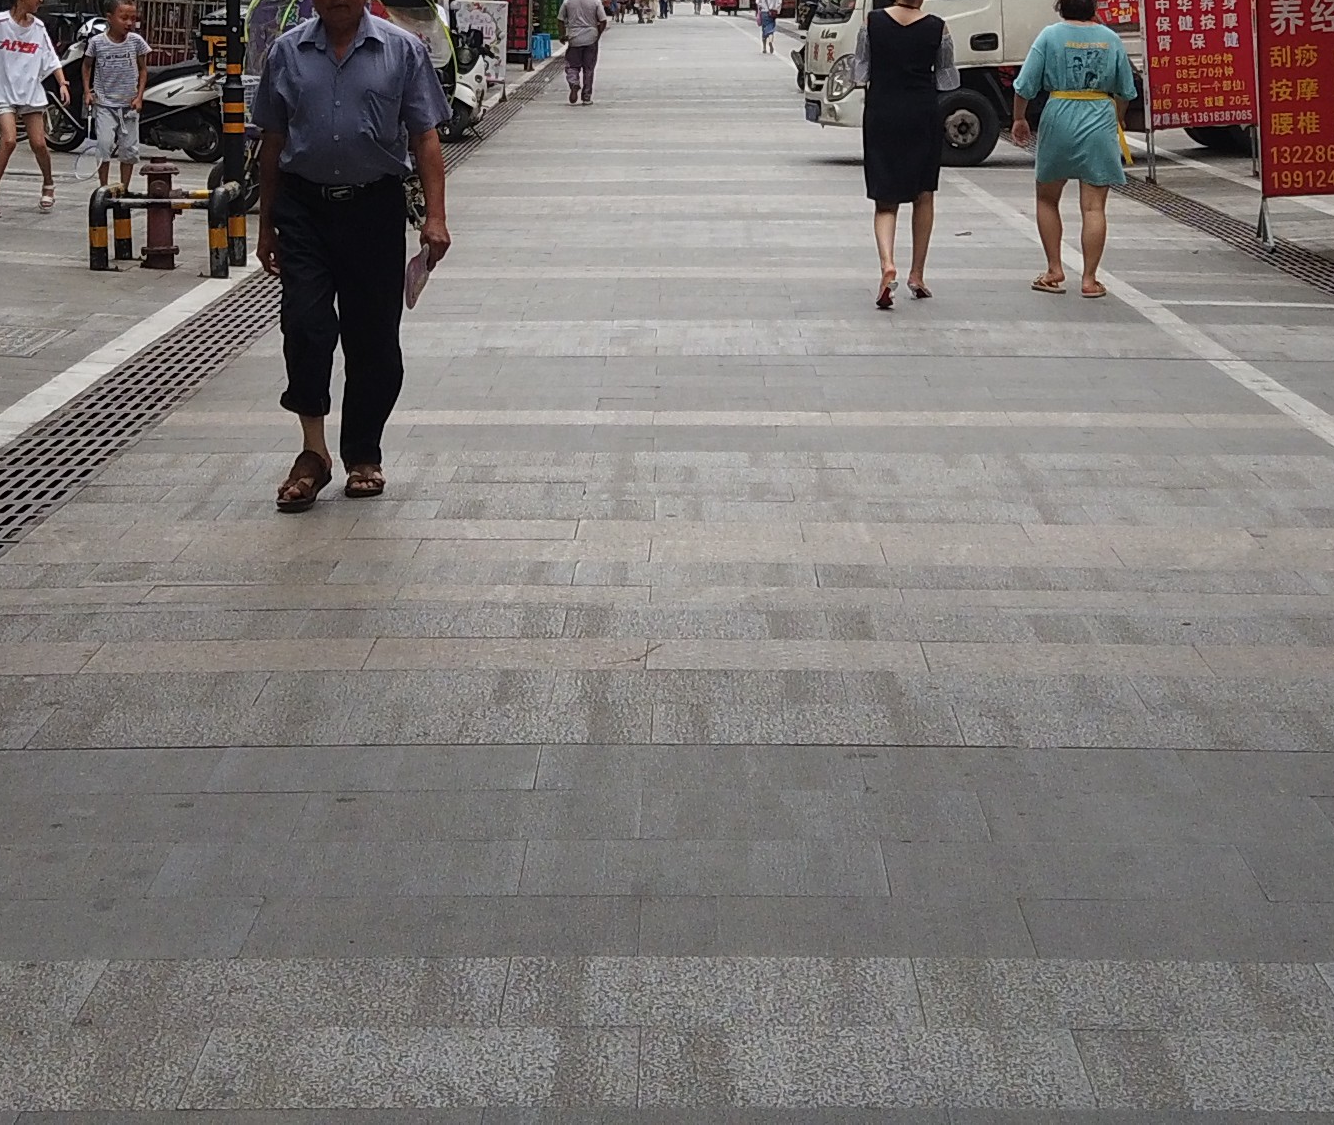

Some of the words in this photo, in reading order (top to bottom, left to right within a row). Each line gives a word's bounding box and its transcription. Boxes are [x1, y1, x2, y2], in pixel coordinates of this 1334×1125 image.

[1155, 13, 1239, 32] 保健按摩
[1269, 43, 1319, 69] 刮痧
[1270, 77, 1320, 102] 按摩
[1270, 111, 1321, 136] 腰椎
